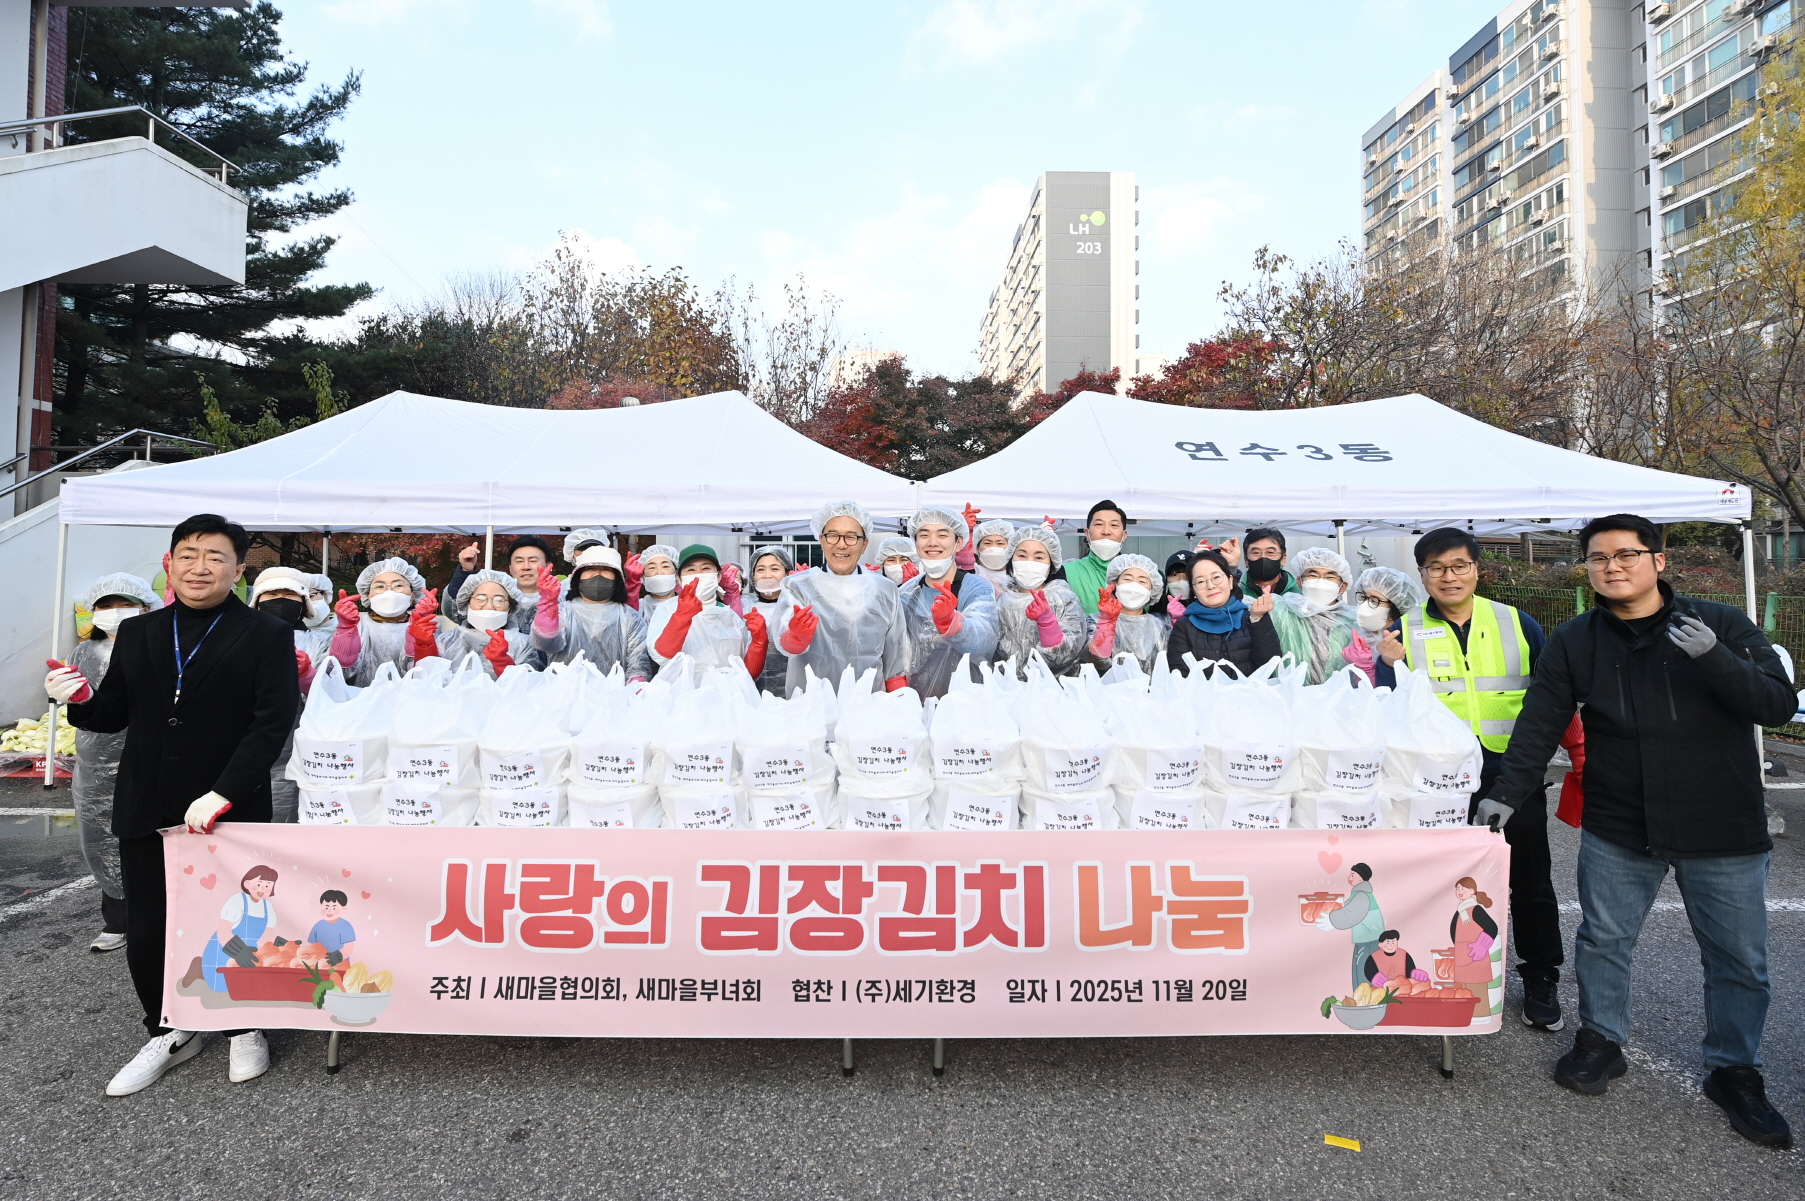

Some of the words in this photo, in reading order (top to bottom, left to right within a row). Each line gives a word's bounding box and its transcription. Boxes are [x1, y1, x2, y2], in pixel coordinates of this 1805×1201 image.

[1070, 223, 1090, 234] LH
[1076, 242, 1102, 254] 203
[1175, 441, 1393, 462] 연수3동
[870, 746, 892, 754] 연수3동
[954, 748, 976, 756] 연수3동
[313, 752, 337, 760] 연수3동
[598, 755, 620, 764] 연수3동
[688, 754, 710, 762] 연수3동
[1246, 754, 1268, 762] 연수3동
[410, 759, 434, 767] 연수3동
[766, 760, 788, 768] 연수3동
[774, 804, 794, 814] 연수3동
[968, 804, 990, 814] 연수3동
[694, 810, 716, 818] 연수3동
[1154, 810, 1176, 819] 연수3동
[1248, 813, 1270, 822] 연수3동
[425, 858, 672, 953] 사랑의
[696, 858, 1049, 956] 김장김치
[1074, 860, 1253, 955] 나눔
[430, 976, 472, 1000] 주최
[494, 976, 628, 1002] 새마을협의회,
[636, 978, 762, 1002] 새마을부녀회
[792, 979, 833, 1002] 협찬
[855, 979, 977, 1004] (주)세기환경
[1006, 980, 1047, 1002] 일자
[1069, 979, 1144, 1002] 2025년
[1152, 980, 1194, 1002] 11월
[1202, 979, 1248, 1002] 20일
